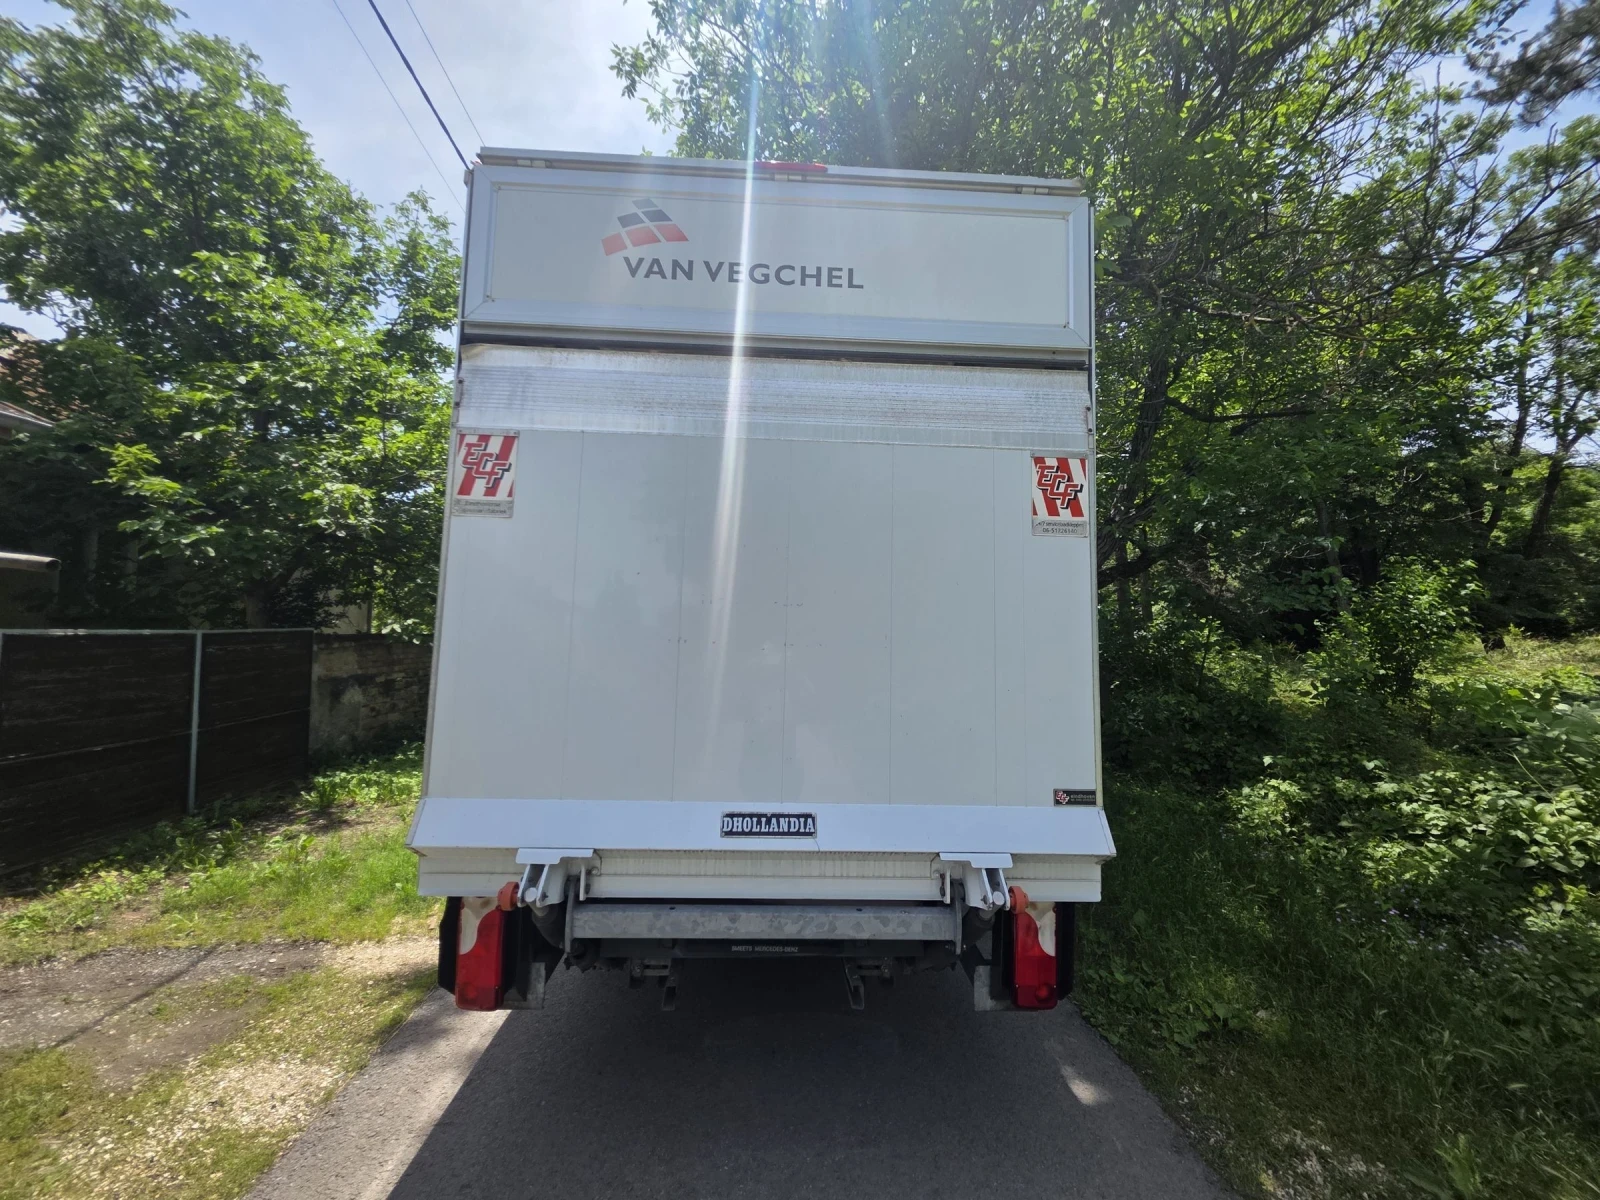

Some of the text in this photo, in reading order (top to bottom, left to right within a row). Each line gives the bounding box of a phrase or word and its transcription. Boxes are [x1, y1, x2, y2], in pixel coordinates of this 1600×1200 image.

[623, 256, 864, 289] VAN VEGCHEL
[461, 442, 512, 489] ECF
[1036, 464, 1084, 509] ECF
[722, 817, 815, 833] DHOLLANDIA
